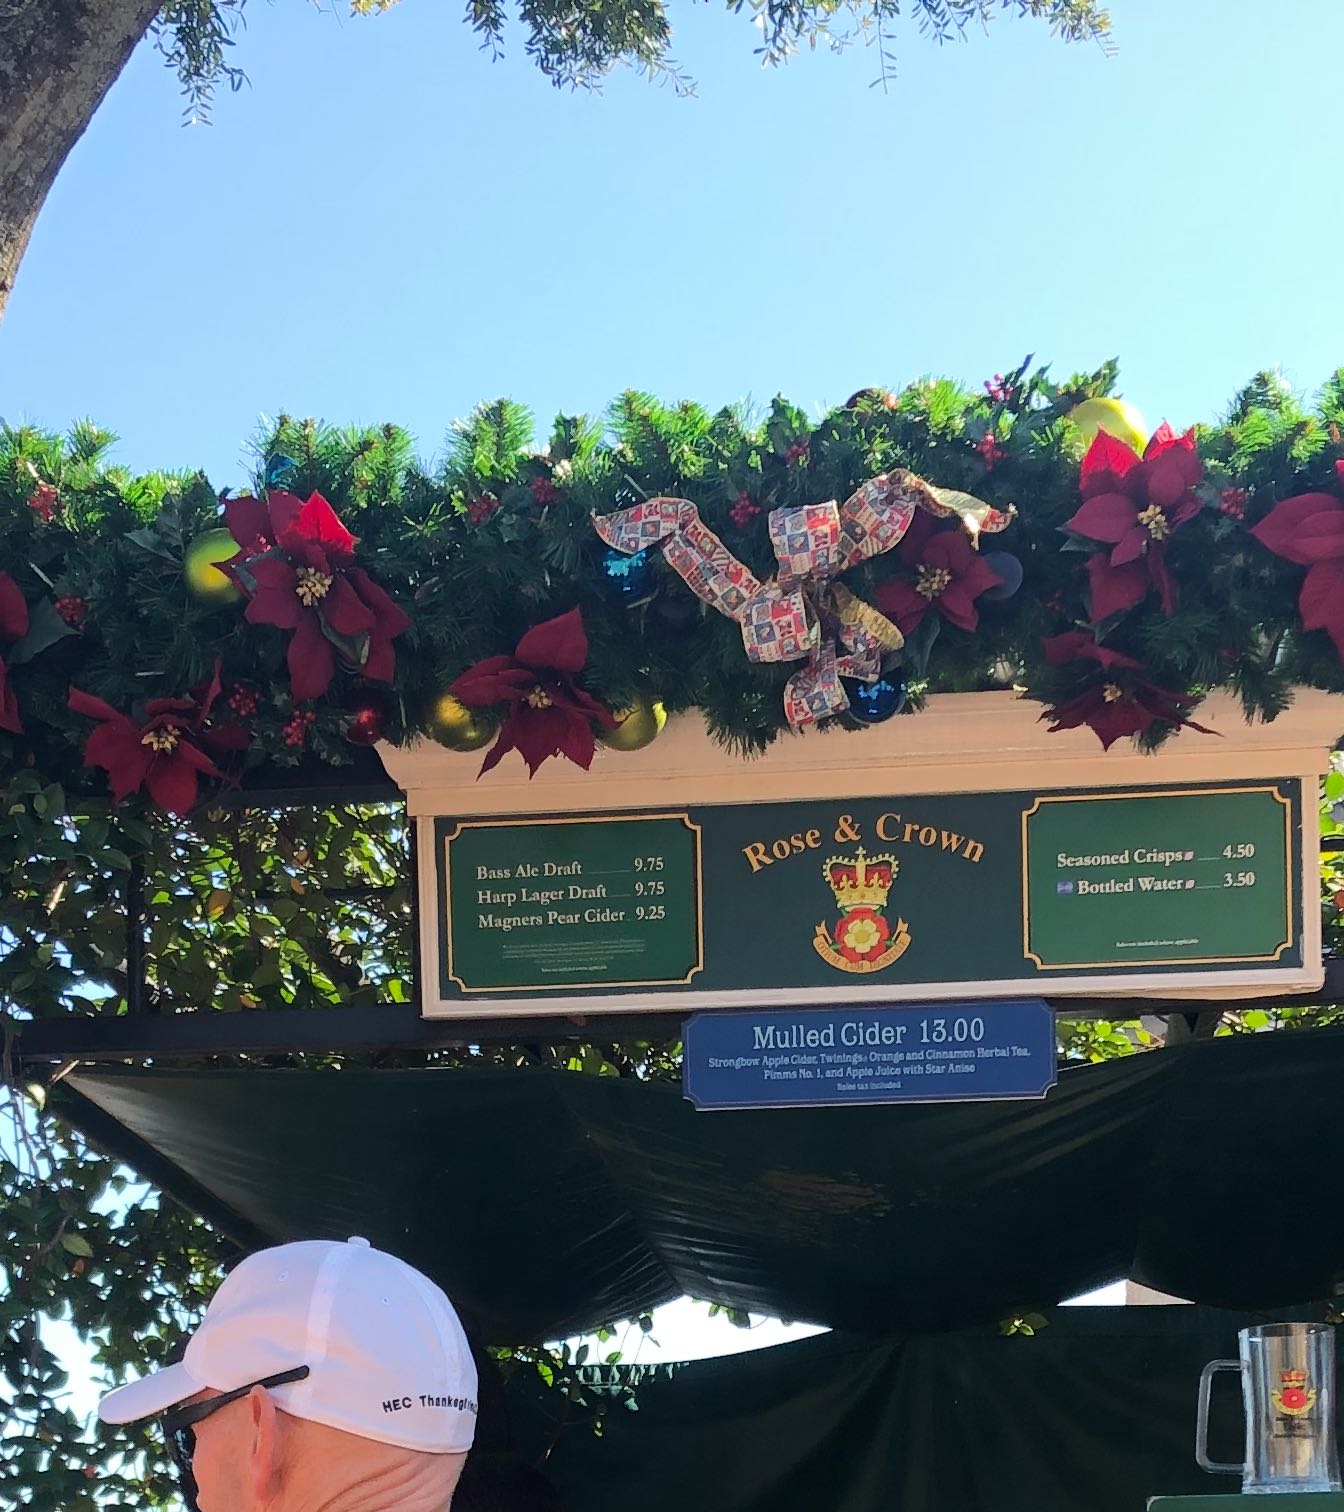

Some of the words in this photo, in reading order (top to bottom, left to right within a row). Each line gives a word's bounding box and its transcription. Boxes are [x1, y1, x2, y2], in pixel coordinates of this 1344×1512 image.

[741, 828, 823, 873] Rose
[834, 814, 862, 843] &
[875, 812, 986, 864] Crown
[1057, 850, 1130, 868] Seasoned
[1133, 848, 1183, 866] Crisps
[1223, 843, 1255, 859] 4.50
[476, 866, 511, 880] Bass
[515, 864, 539, 878] Ale
[544, 861, 582, 877] Draft
[634, 857, 664, 872] 9.75
[477, 890, 517, 906] Harp
[521, 888, 565, 906] Lager
[569, 884, 607, 899] Draft
[634, 881, 665, 897] 9.75
[1077, 877, 1134, 895] Bottled
[1138, 876, 1183, 891] Water
[1223, 871, 1255, 887] 3.50
[478, 914, 543, 932] Magners
[547, 911, 581, 925] Pear
[584, 908, 626, 923] Cider
[635, 905, 666, 921] 9.25
[752, 1023, 835, 1050] Mulled
[840, 1021, 907, 1047] Cider
[920, 1017, 985, 1043] 13.00
[708, 1057, 760, 1069] Strongbow
[762, 1055, 790, 1068] Apple
[869, 1051, 904, 1064] Orange
[906, 1050, 924, 1061] and
[925, 1049, 976, 1061] Cinnamon
[977, 1047, 1009, 1058] Herbal
[764, 1069, 797, 1080] Pimms
[799, 1068, 814, 1079] No.
[825, 1067, 844, 1078] and
[846, 1066, 874, 1079] Apple
[874, 1065, 901, 1077] Juice
[903, 1064, 924, 1075] with
[925, 1063, 946, 1074] Star
[948, 1062, 976, 1073] Anise
[382, 1396, 413, 1413] HEC
